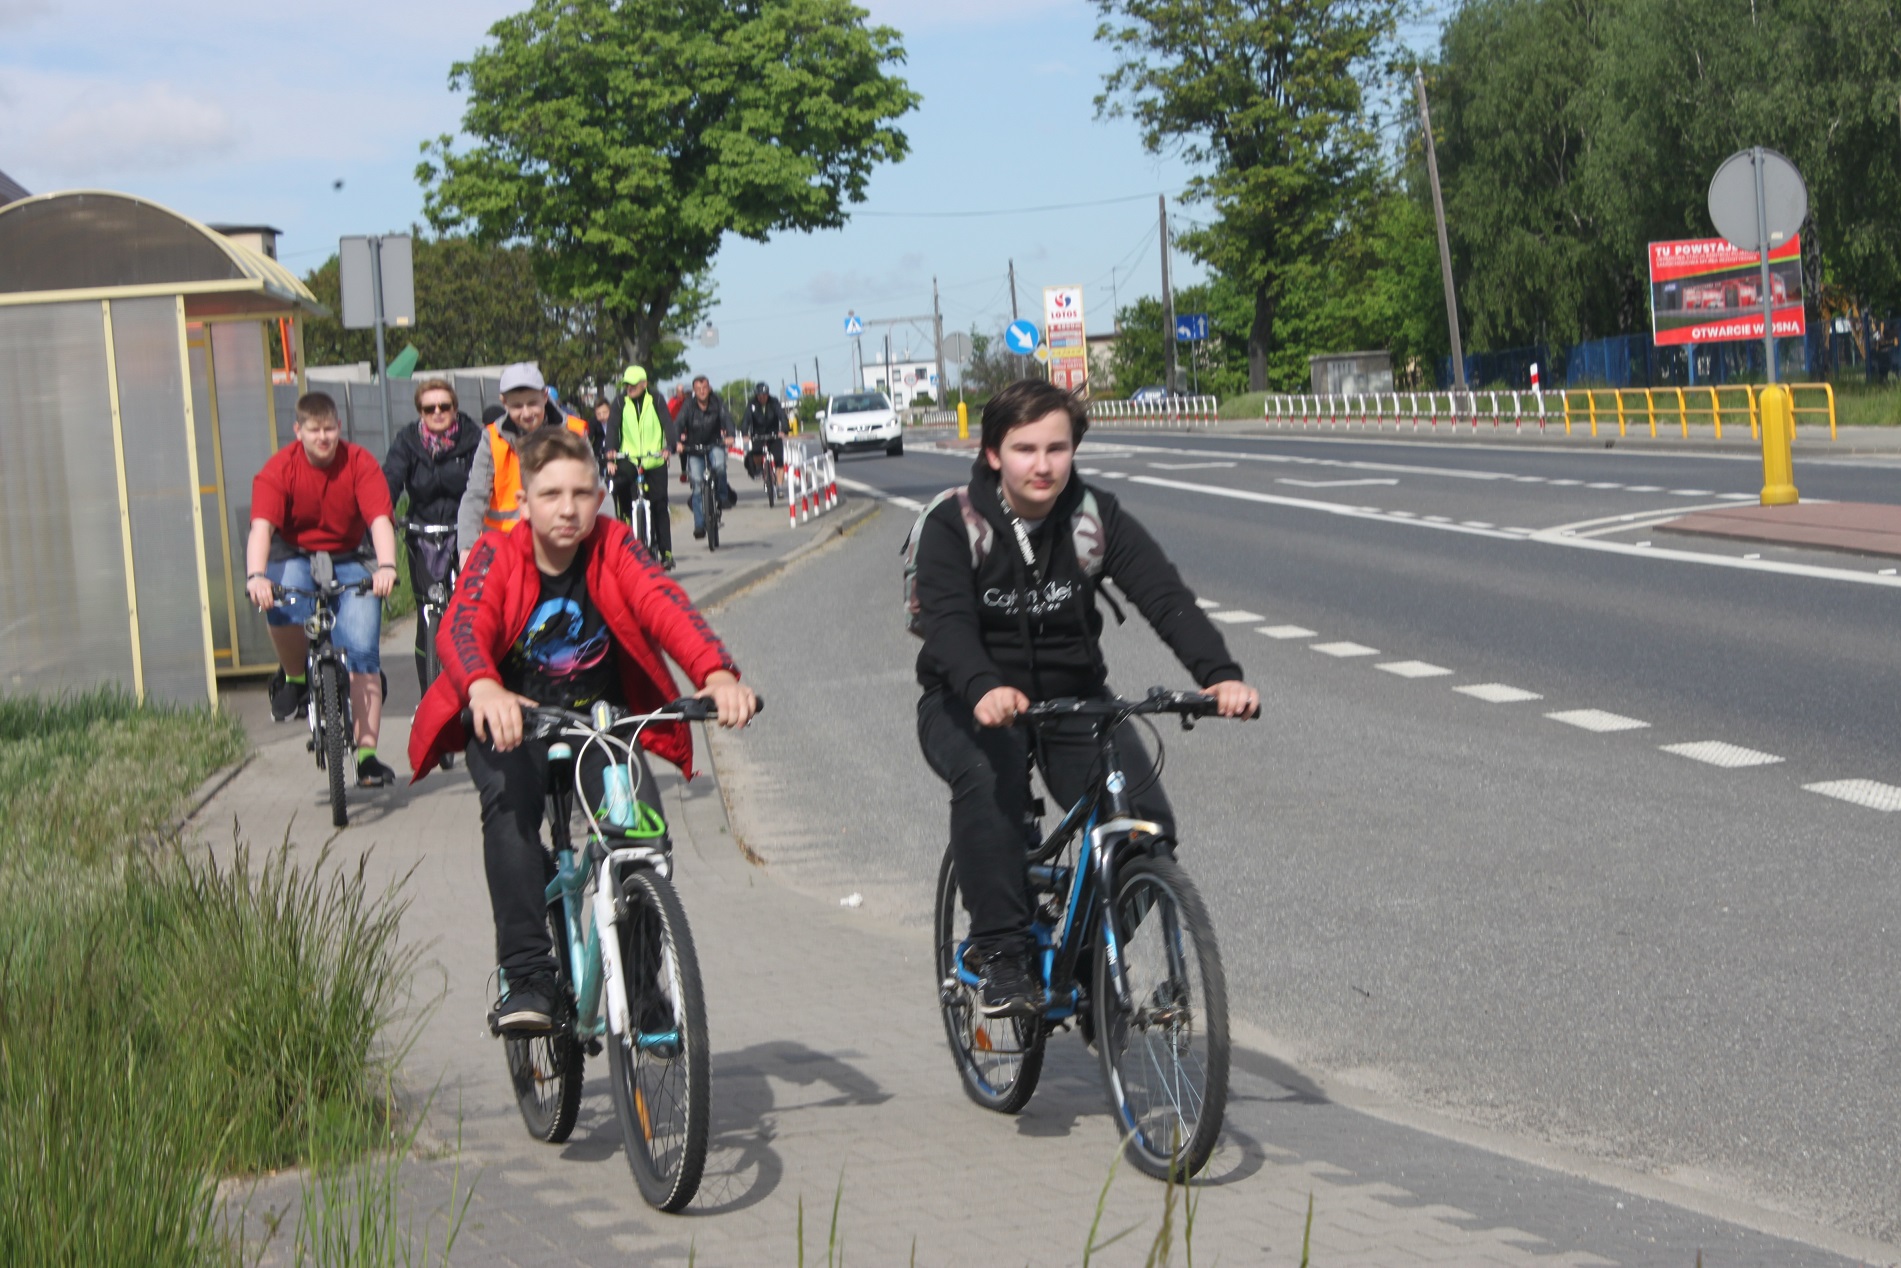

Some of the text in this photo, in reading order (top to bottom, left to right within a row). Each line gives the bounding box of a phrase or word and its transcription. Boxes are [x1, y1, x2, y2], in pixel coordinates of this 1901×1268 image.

[1655, 246, 1670, 256] TU
[1051, 310, 1077, 319] LOTOS
[1691, 321, 1800, 340] OTWARCIE WSNĄ
